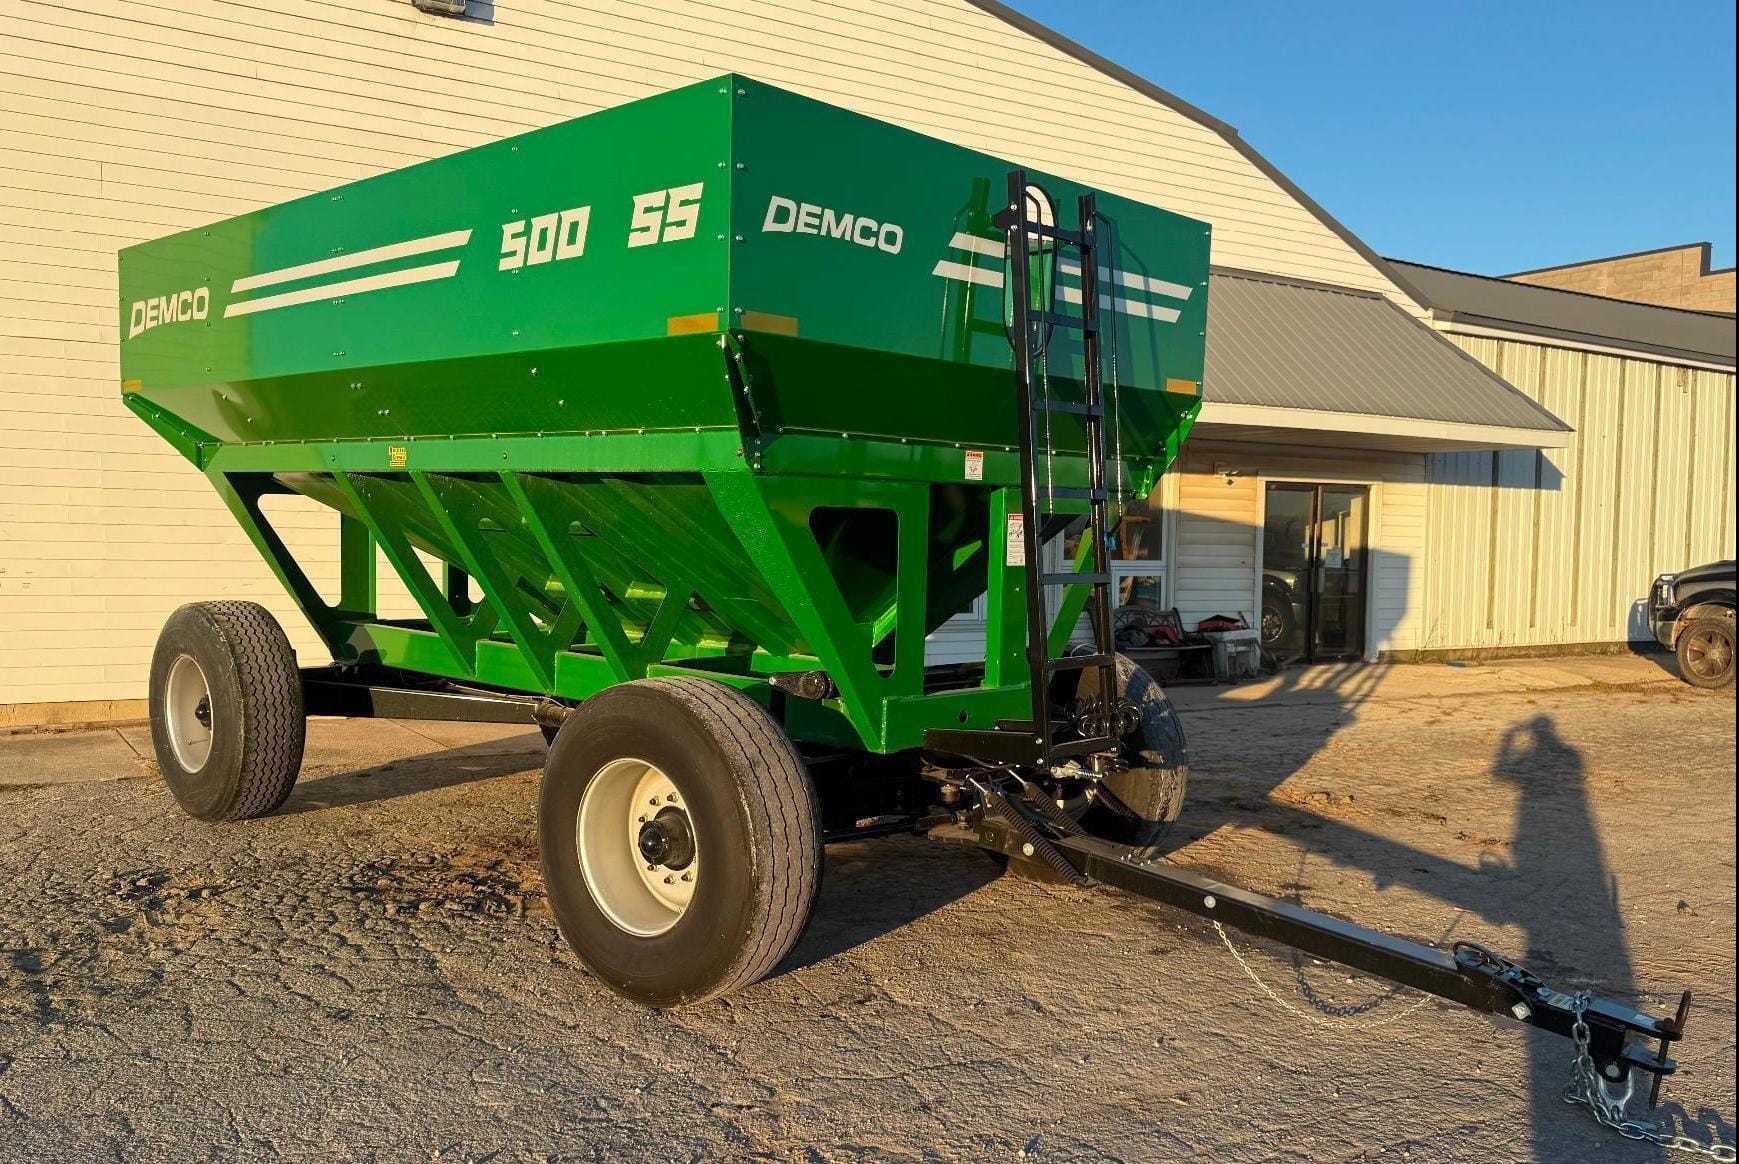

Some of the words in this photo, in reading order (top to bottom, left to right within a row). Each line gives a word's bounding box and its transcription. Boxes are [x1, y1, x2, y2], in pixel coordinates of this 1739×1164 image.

[498, 205, 591, 271] 500
[762, 195, 904, 255] DEMCO
[128, 286, 210, 340] DEMCO
